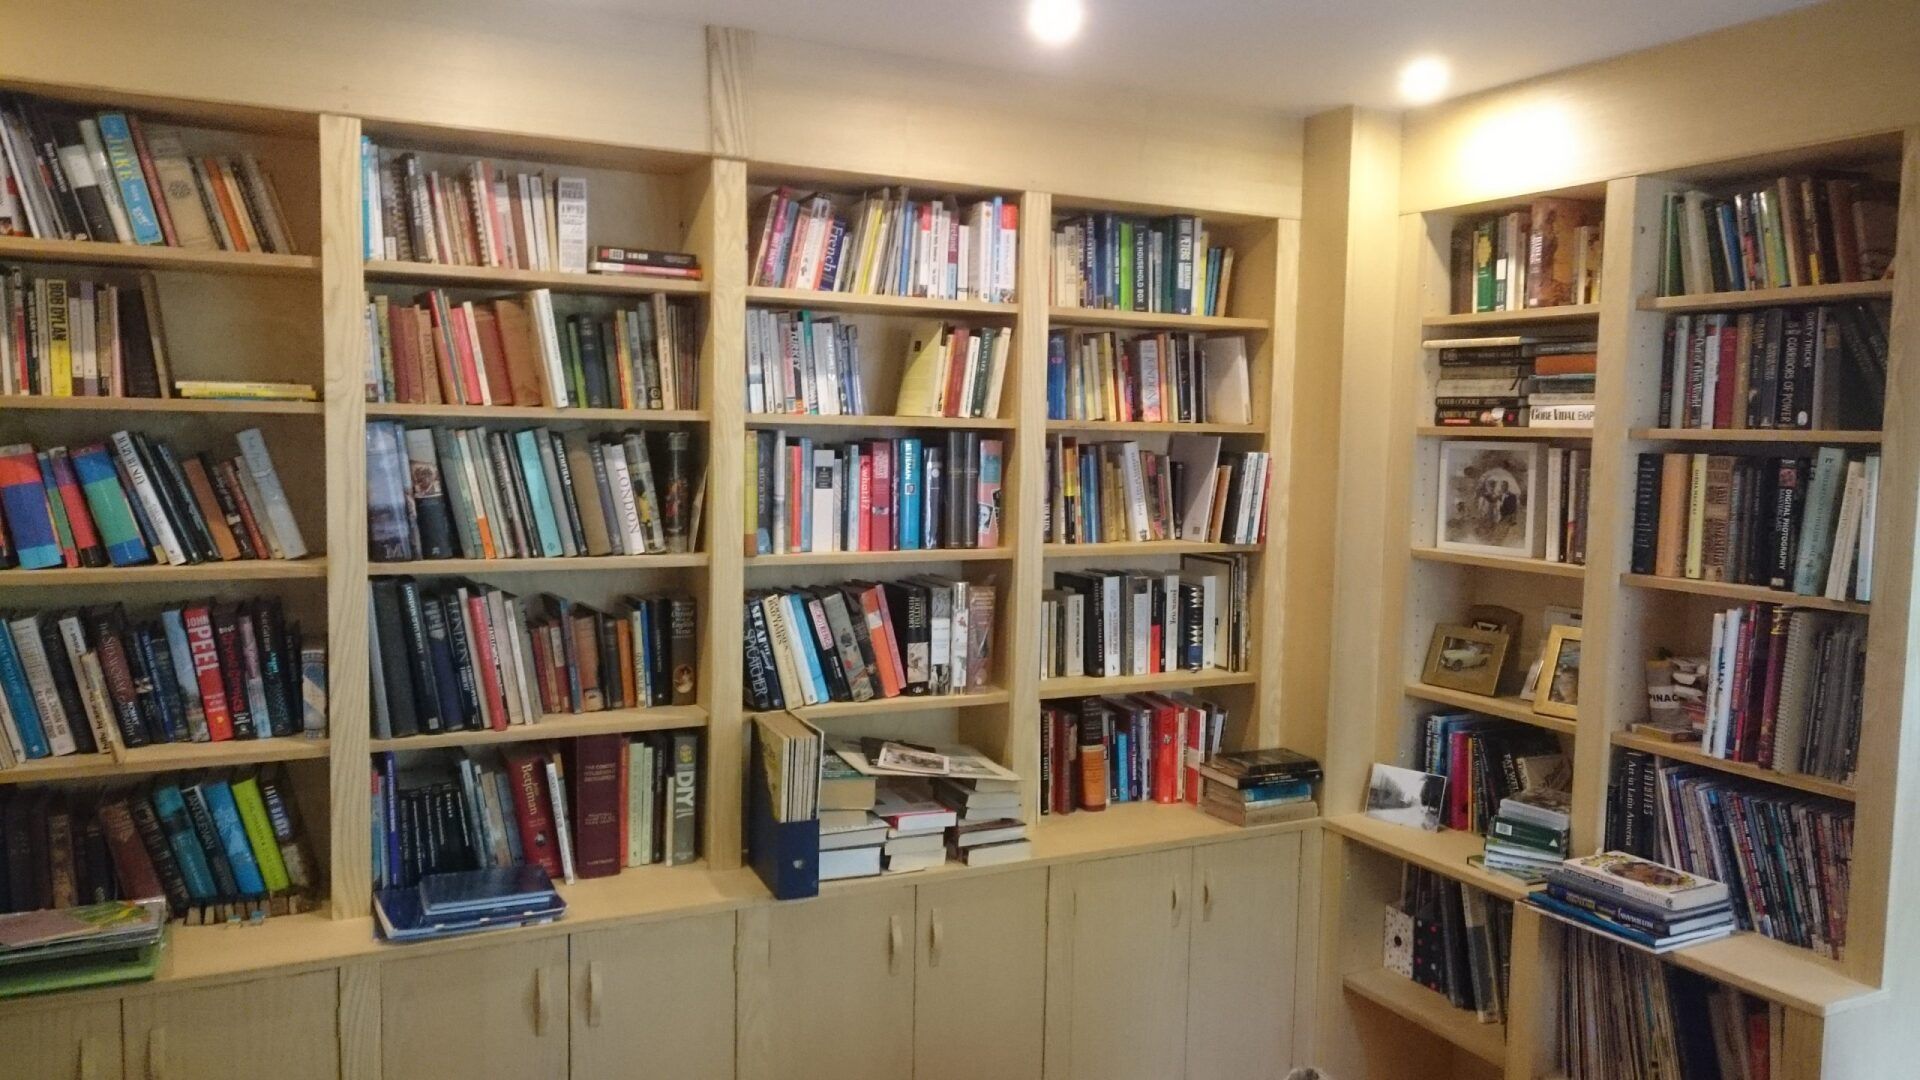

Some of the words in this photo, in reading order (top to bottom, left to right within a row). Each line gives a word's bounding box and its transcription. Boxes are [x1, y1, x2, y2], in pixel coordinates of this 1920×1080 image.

[823, 226, 844, 272] French
[949, 223, 959, 253] Ireland
[1181, 235, 1192, 260] PETERS
[51, 282, 65, 306] BOB
[1136, 289, 1144, 304] BOX
[52, 307, 67, 341] DYLAN
[1806, 312, 1814, 336] DIRTY
[791, 330, 800, 369] TURKEY
[1694, 338, 1704, 353] Out
[1784, 337, 1797, 379] CORRIDORS
[1804, 339, 1813, 368] TRICKS
[1691, 383, 1702, 408] World
[1783, 381, 1793, 392] OF
[1531, 408, 1552, 421] GORE
[1553, 408, 1576, 421] VIDAL
[1780, 393, 1793, 422] POWER
[556, 438, 572, 485] SMITHFIELD
[861, 469, 871, 495] what
[616, 467, 640, 535] LONDON
[1783, 489, 1793, 516] DIGITAL
[1778, 518, 1790, 570] PHOTOGRAPHY
[406, 586, 416, 616] LONDON
[187, 617, 209, 628] JOHN
[448, 600, 468, 662] LONDON
[813, 601, 834, 649] MICROTRENDS
[188, 625, 220, 676] PEEL
[745, 630, 768, 697] SPYCATCHER
[127, 701, 140, 725] ROBERT
[1627, 760, 1637, 776] Art
[521, 763, 539, 816] Betjeman
[676, 770, 695, 807] DIY
[1627, 788, 1636, 809] Latin
[270, 808, 291, 836] BANKS
[1625, 810, 1636, 847] America
